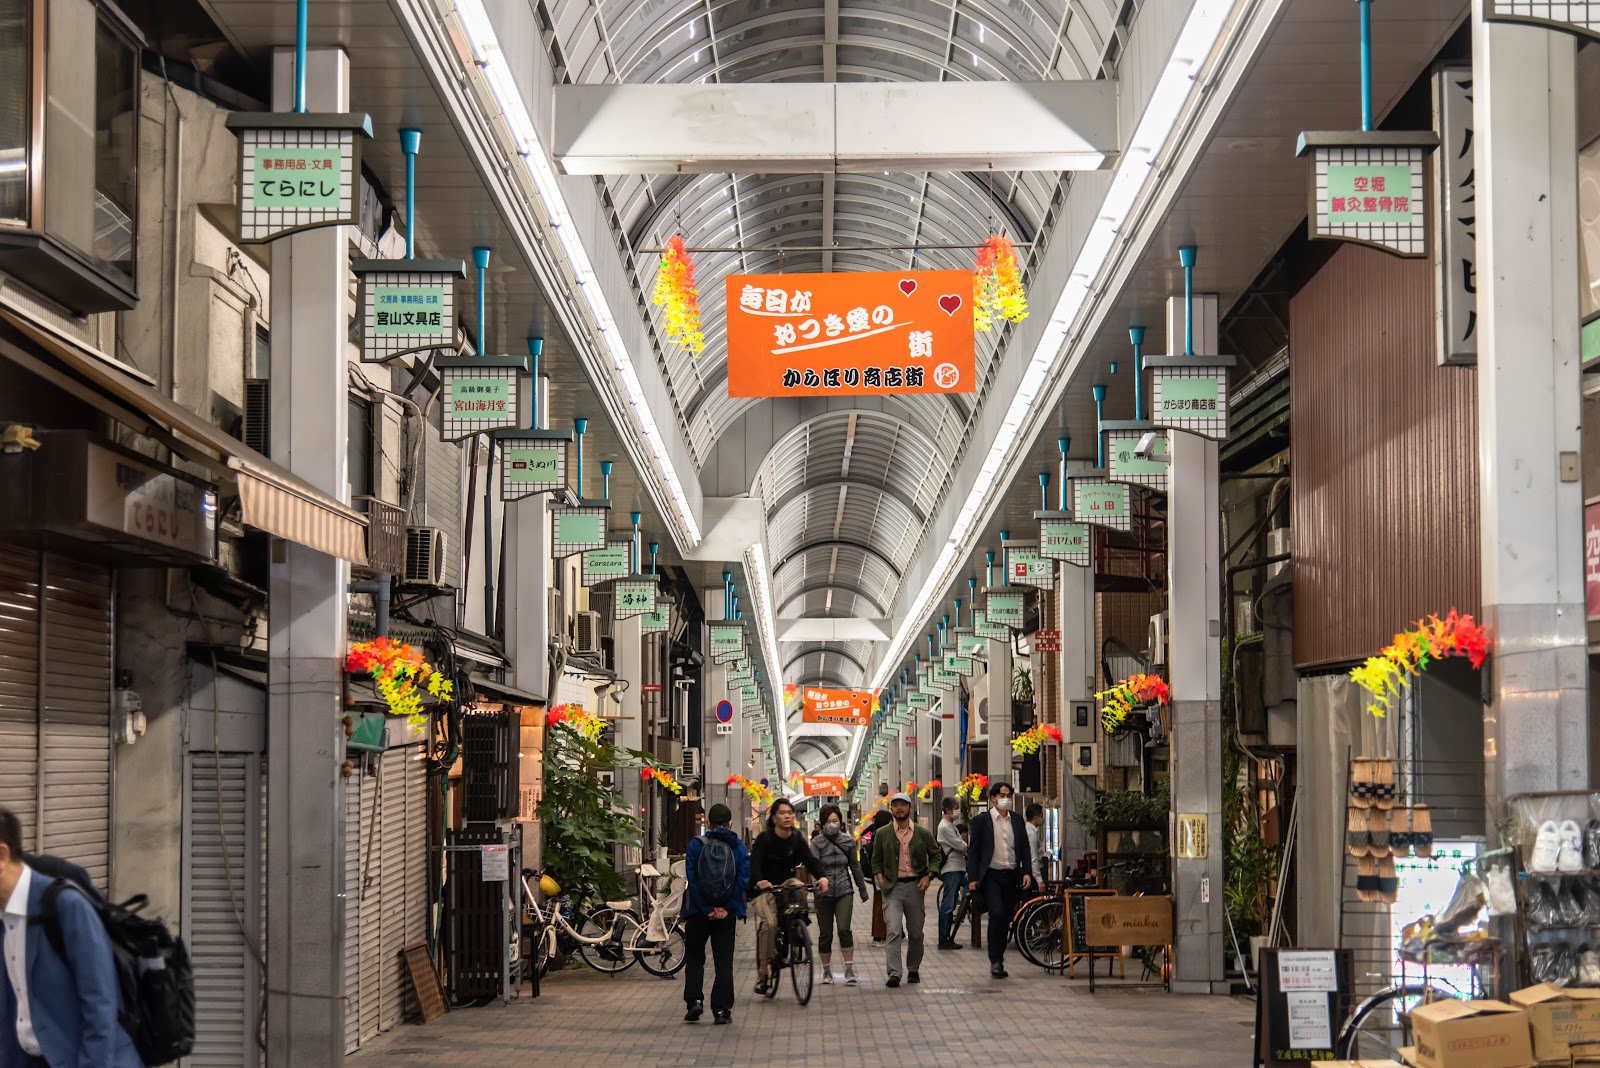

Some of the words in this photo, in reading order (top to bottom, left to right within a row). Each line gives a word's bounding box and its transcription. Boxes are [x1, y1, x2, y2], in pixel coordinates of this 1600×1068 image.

[263, 159, 333, 170] 事務用品・文具
[259, 180, 335, 197] てらにし
[1354, 176, 1386, 192] 空堀
[1331, 196, 1409, 213] 鍼灸整骨院
[739, 284, 813, 313] 毎日が
[377, 311, 441, 326] 宮山文具店
[908, 330, 934, 358] 街
[782, 366, 925, 388] からほり商店街
[460, 385, 500, 394] 高級御菓子
[454, 399, 506, 412] 宮山海月堂
[1163, 399, 1216, 410] からほり商店街
[1090, 500, 1115, 510] 山田
[589, 559, 622, 567] Caracara
[1123, 914, 1159, 928] minka
